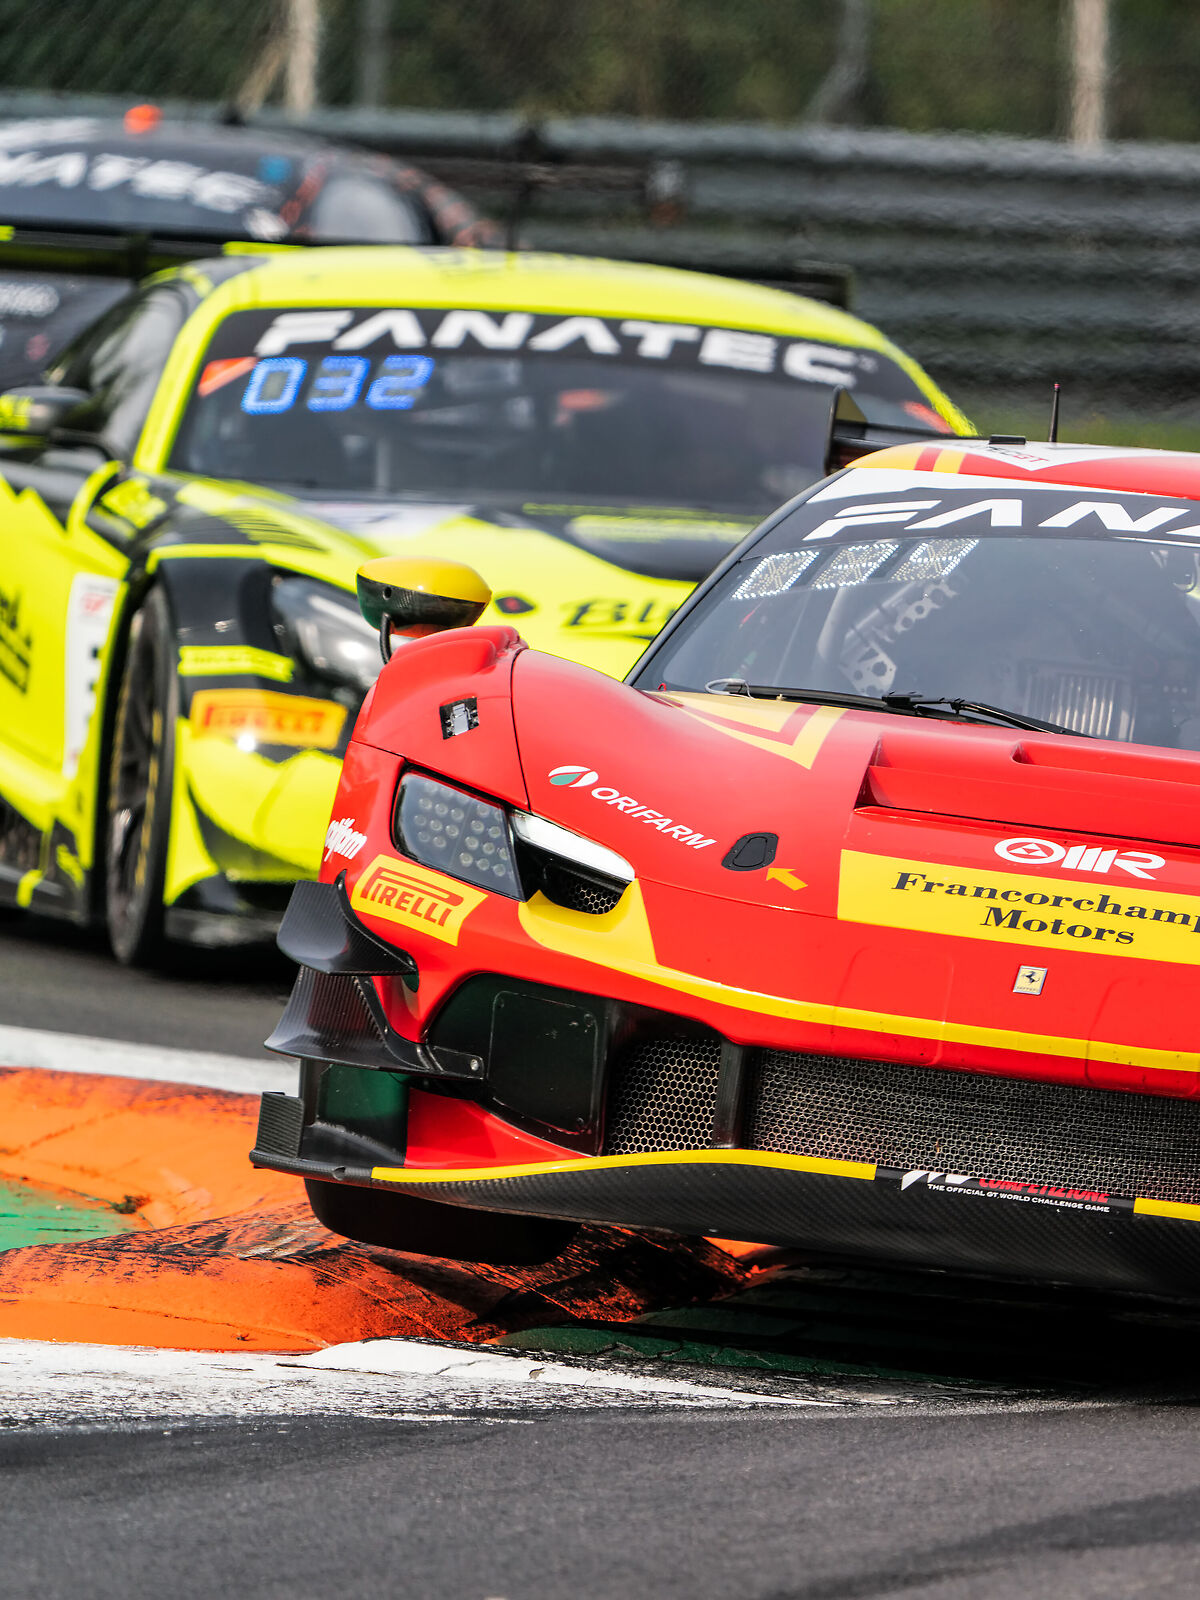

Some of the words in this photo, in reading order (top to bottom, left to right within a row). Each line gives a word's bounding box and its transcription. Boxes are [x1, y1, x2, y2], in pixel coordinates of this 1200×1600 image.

[255, 310, 856, 388] FANATEC
[241, 355, 434, 414] 032
[591, 786, 717, 850] ORIFARM
[360, 866, 465, 927] PIRELLI
[980, 906, 1135, 946] Motors
[927, 1183, 944, 1193] THE
[946, 1186, 986, 1198] OFFICIAL
[986, 1191, 998, 1200] GT
[999, 1194, 1031, 1204] WORLD
[1031, 1197, 1084, 1210] CHALLENGE
[1084, 1204, 1111, 1213] GAME
